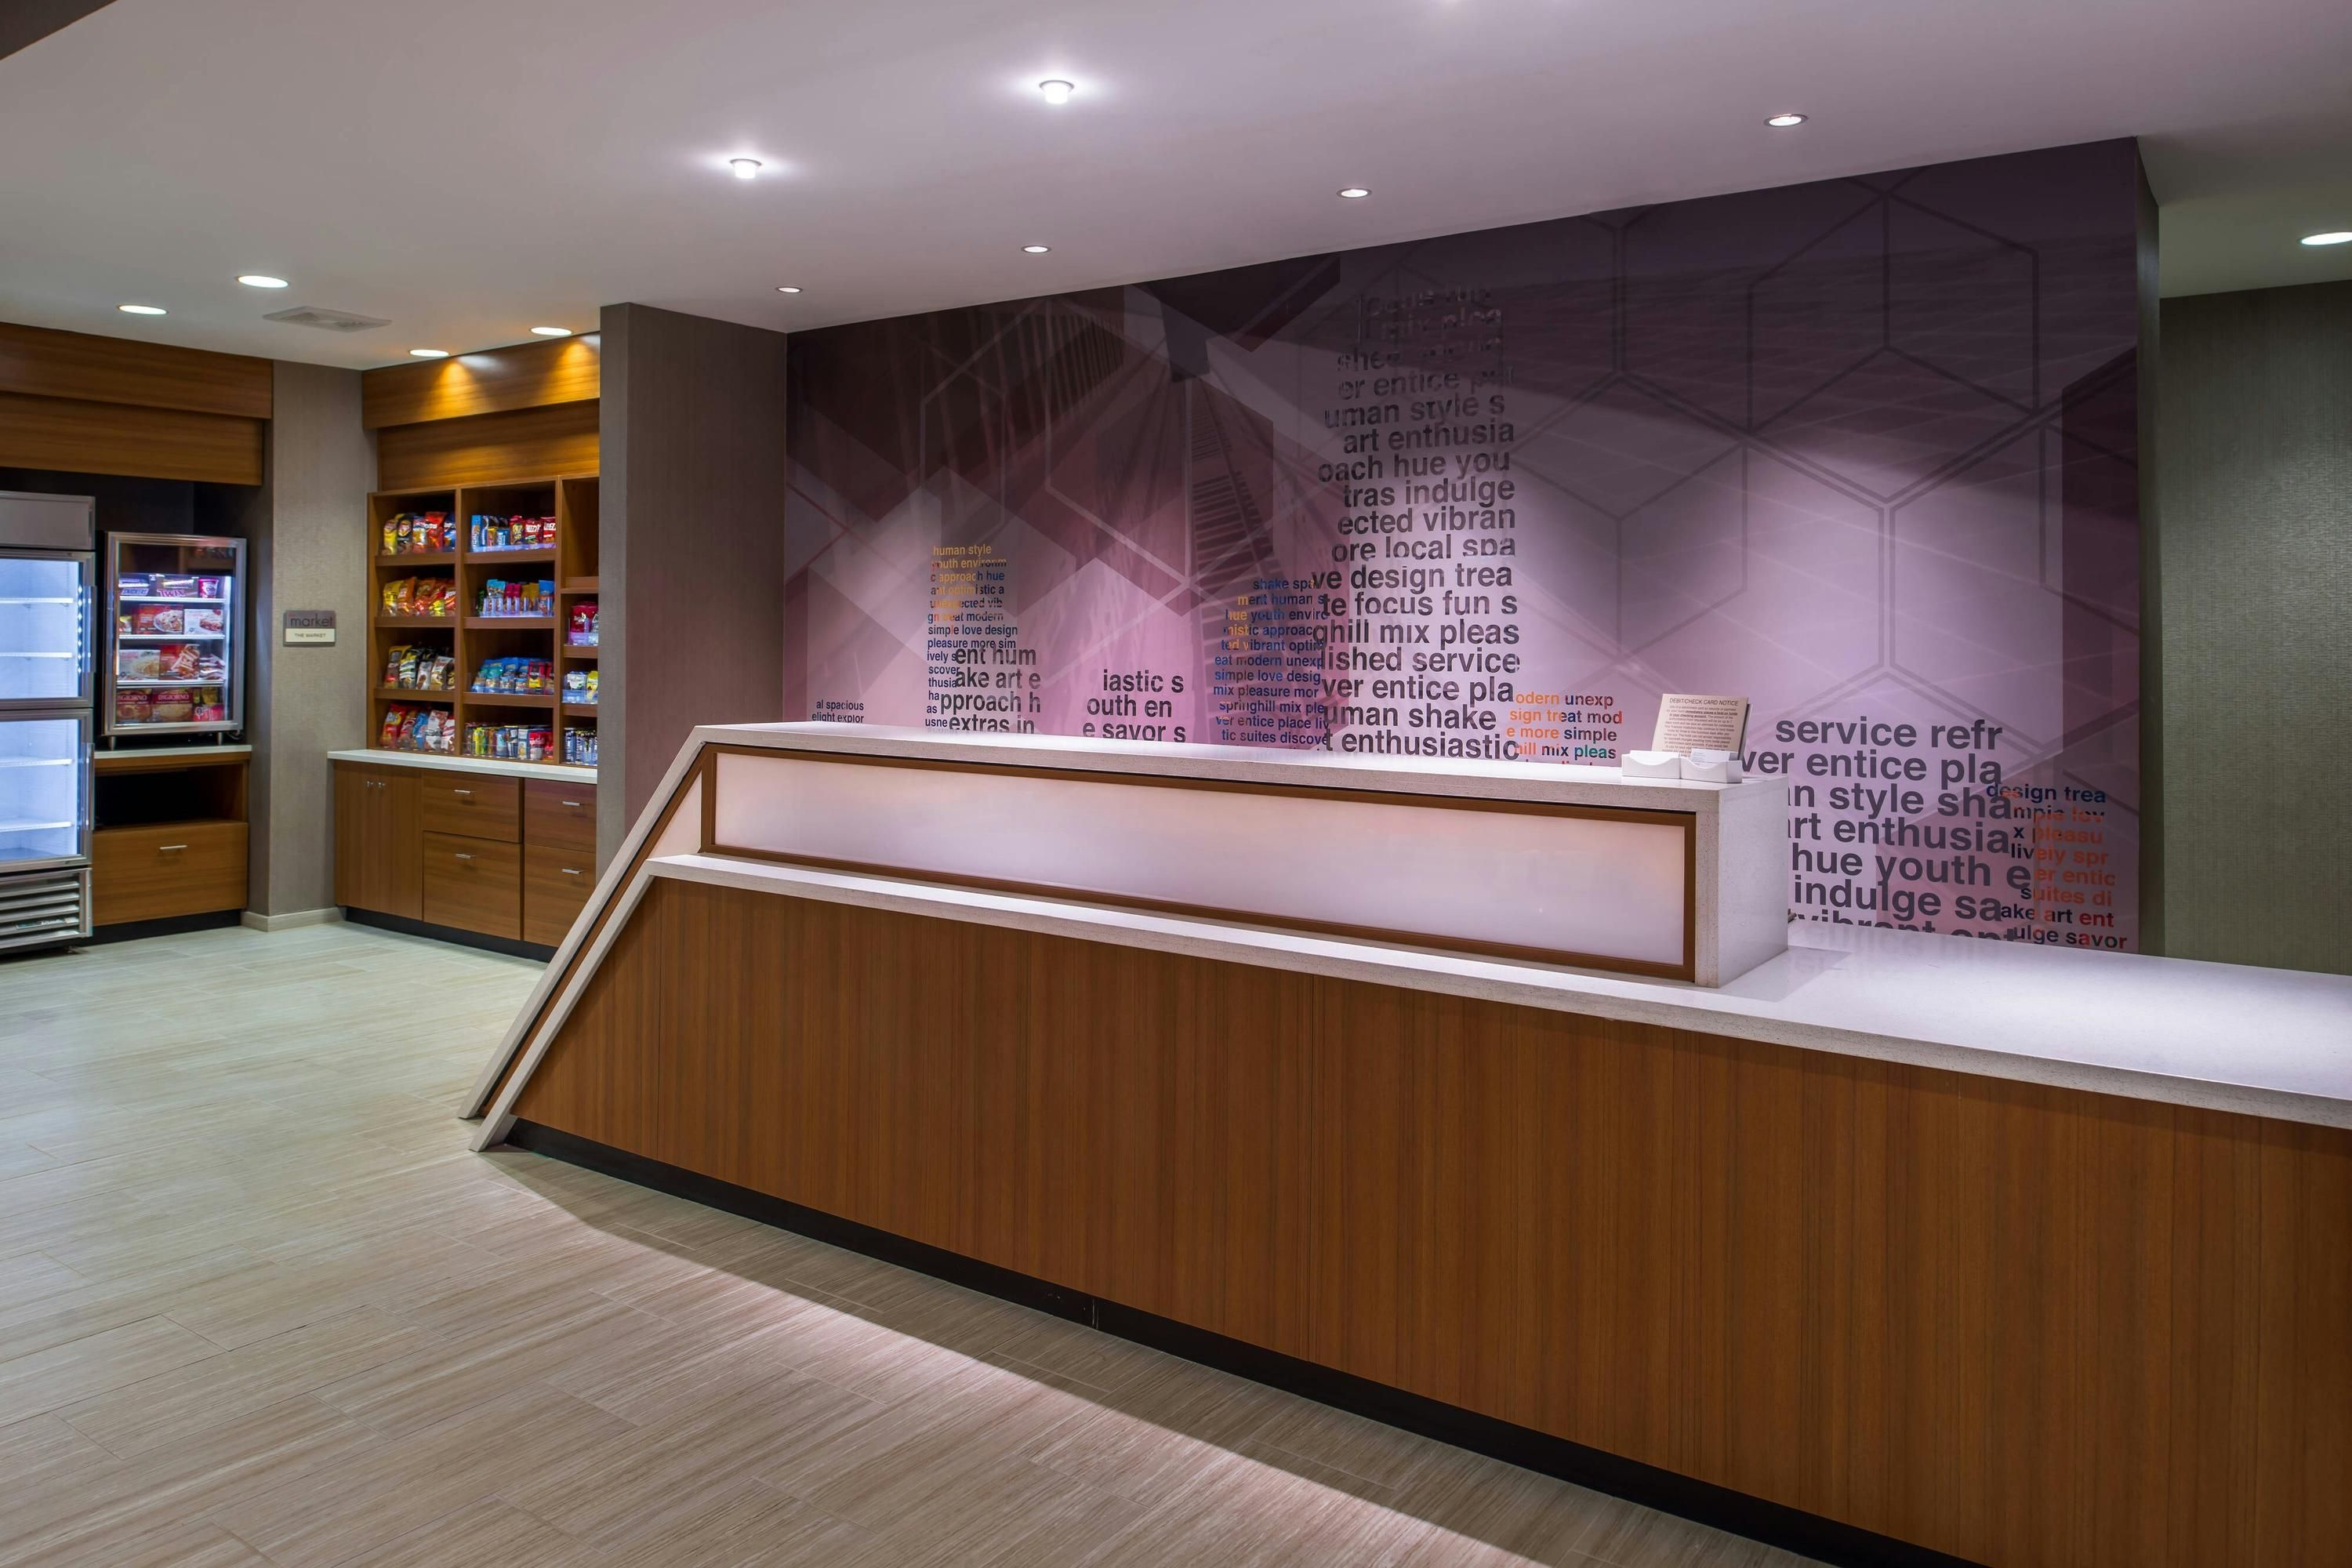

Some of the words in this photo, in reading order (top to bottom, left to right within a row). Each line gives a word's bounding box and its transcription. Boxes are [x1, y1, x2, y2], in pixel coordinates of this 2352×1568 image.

[1374, 369, 1460, 397] entice
[1324, 404, 1399, 428] uman
[1411, 394, 1479, 426] style
[1490, 394, 1505, 415] s
[1344, 429, 1379, 453] art
[1388, 419, 1514, 450] enthusia
[1318, 455, 1383, 482] oach
[1393, 453, 1446, 477] hue
[1455, 452, 1510, 481] you
[1343, 485, 1396, 508] tras
[1405, 476, 1515, 508] indulge
[1338, 508, 1412, 535] ected
[1423, 506, 1515, 532] vibran
[933, 545, 965, 556] human
[968, 544, 992, 557] style
[1332, 542, 1376, 562] ore
[1385, 534, 1451, 560] local
[939, 571, 982, 583] approach
[986, 571, 1004, 581] hue
[1253, 578, 1289, 590] shake
[1311, 570, 1342, 589] ve
[1351, 564, 1444, 594] design
[1455, 563, 1512, 587] trea
[1237, 594, 1268, 605] ment
[1272, 593, 1313, 604] human
[1323, 593, 1347, 616] te
[1355, 592, 1433, 615] focus
[1443, 590, 1490, 615] fun
[1501, 595, 1518, 615] s
[291, 613, 332, 627] market
[1250, 610, 1285, 623] youth
[928, 626, 959, 637] simple
[962, 626, 982, 635] love
[985, 626, 1018, 637] design
[1312, 619, 1370, 649] ghill
[1380, 624, 1430, 644] mix
[1440, 619, 1520, 651] pleas
[927, 638, 968, 650] pleasure
[971, 640, 996, 648] more
[998, 639, 1016, 648] sim
[1243, 640, 1285, 651] vibrant
[927, 651, 949, 663] ively
[955, 647, 985, 665] ent
[993, 644, 1036, 665] hum
[1215, 656, 1232, 666] eat
[1236, 655, 1281, 666] modern
[1321, 646, 1402, 671] lished
[1412, 647, 1521, 673] service
[928, 677, 957, 688] thusia
[956, 667, 989, 688] ake
[996, 670, 1022, 688] art
[1029, 673, 1041, 689] e
[1103, 669, 1163, 692] iastic
[1171, 675, 1184, 693] s
[1215, 670, 1254, 683] simple
[1258, 670, 1283, 681] love
[1287, 670, 1320, 684] desig
[928, 691, 939, 700] ha
[1214, 684, 1234, 695] mix
[1239, 685, 1290, 699] pleasure
[1322, 678, 1364, 698] ver
[1372, 674, 1460, 700] entice
[1469, 676, 1515, 707] pla
[816, 699, 824, 709] al
[826, 700, 864, 711] spacious
[941, 691, 1022, 715] pproach
[1029, 691, 1040, 713] h
[1087, 695, 1137, 716] outh
[1145, 700, 1172, 717] en
[1219, 700, 1275, 714] springhill
[1279, 701, 1301, 713] mix
[1305, 702, 1324, 715] ple
[1515, 691, 1559, 705] odern
[1565, 695, 1613, 710] unexp
[925, 717, 948, 727] usne
[1017, 715, 1035, 734] in
[1216, 716, 1234, 726] ver
[1238, 717, 1274, 727] entice
[1278, 717, 1311, 730] place
[1324, 705, 1399, 726] uman
[1408, 702, 1497, 731] shake
[1510, 708, 1541, 724] sign
[1547, 710, 1582, 722] treat
[1588, 711, 1622, 724] mod
[1102, 723, 1166, 741] savor
[1174, 726, 1186, 742] s
[1222, 730, 1236, 740] tic
[1240, 731, 1276, 742] suites
[1507, 728, 1515, 737] e
[1520, 728, 1559, 739] more
[1564, 727, 1617, 744] simple
[1775, 715, 1918, 748] service
[1931, 719, 2003, 750] refr
[1341, 729, 1520, 760] enthusiastic
[1541, 745, 1569, 756] mix
[1574, 745, 1616, 760] pleas
[1741, 750, 1795, 775] ver
[1806, 749, 1928, 781] entice
[1940, 753, 2002, 790] pla
[1829, 783, 1925, 820] style
[1937, 787, 2013, 820] sha
[1986, 784, 2057, 804] design
[2064, 786, 2107, 804] trea
[1834, 817, 2009, 854] enthusia
[2013, 827, 2024, 839] x
[2032, 825, 2103, 844] pleasu
[2011, 844, 2067, 866] lively
[2074, 850, 2108, 868] spr
[1792, 842, 1863, 877] hue
[1875, 855, 1991, 887] youth
[2006, 864, 2031, 890] e
[2034, 868, 2057, 881] er
[2063, 869, 2116, 887] entic
[1795, 874, 1941, 922] indulge
[1955, 895, 2002, 922] sa
[2020, 887, 2085, 904] suites
[2092, 890, 2112, 907] di
[2001, 904, 2037, 920] ake
[2045, 909, 2073, 924] art
[2079, 912, 2114, 928] ent
[2066, 931, 2127, 949] savor
